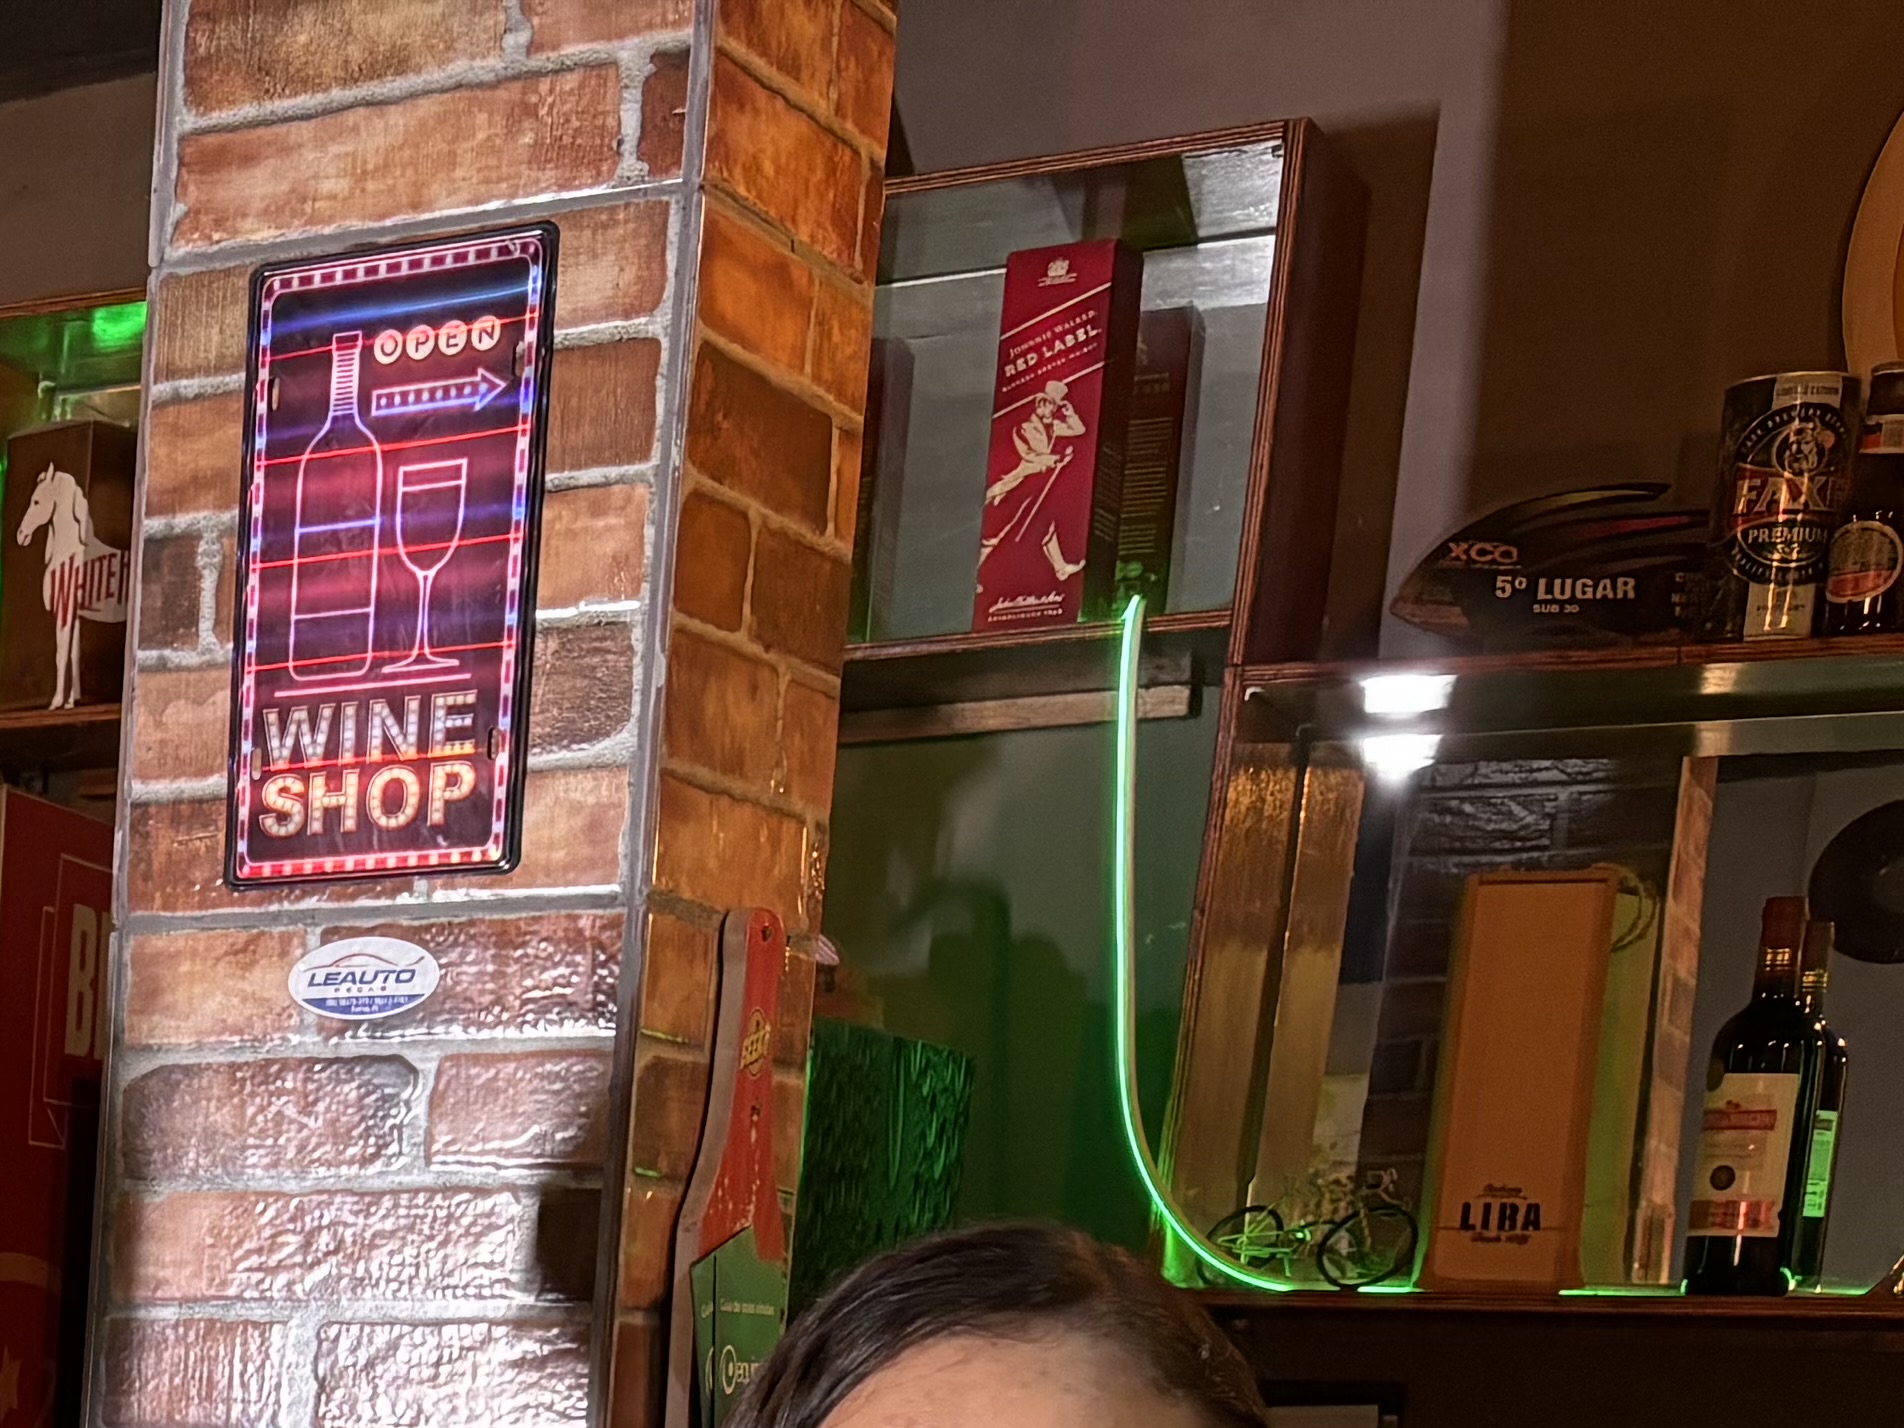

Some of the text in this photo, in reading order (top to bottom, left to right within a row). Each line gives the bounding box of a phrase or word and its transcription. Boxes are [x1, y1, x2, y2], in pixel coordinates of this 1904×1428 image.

[376, 316, 499, 362] OPEN
[1003, 352, 1038, 378] RED
[1042, 323, 1102, 358] LABEL
[1747, 523, 1829, 545] PREMIUM
[50, 552, 118, 630] WHITE
[1536, 576, 1637, 601] LUGAR
[262, 668, 478, 772] WINE
[258, 759, 477, 838] SHOP
[307, 968, 416, 988] LEAUTO
